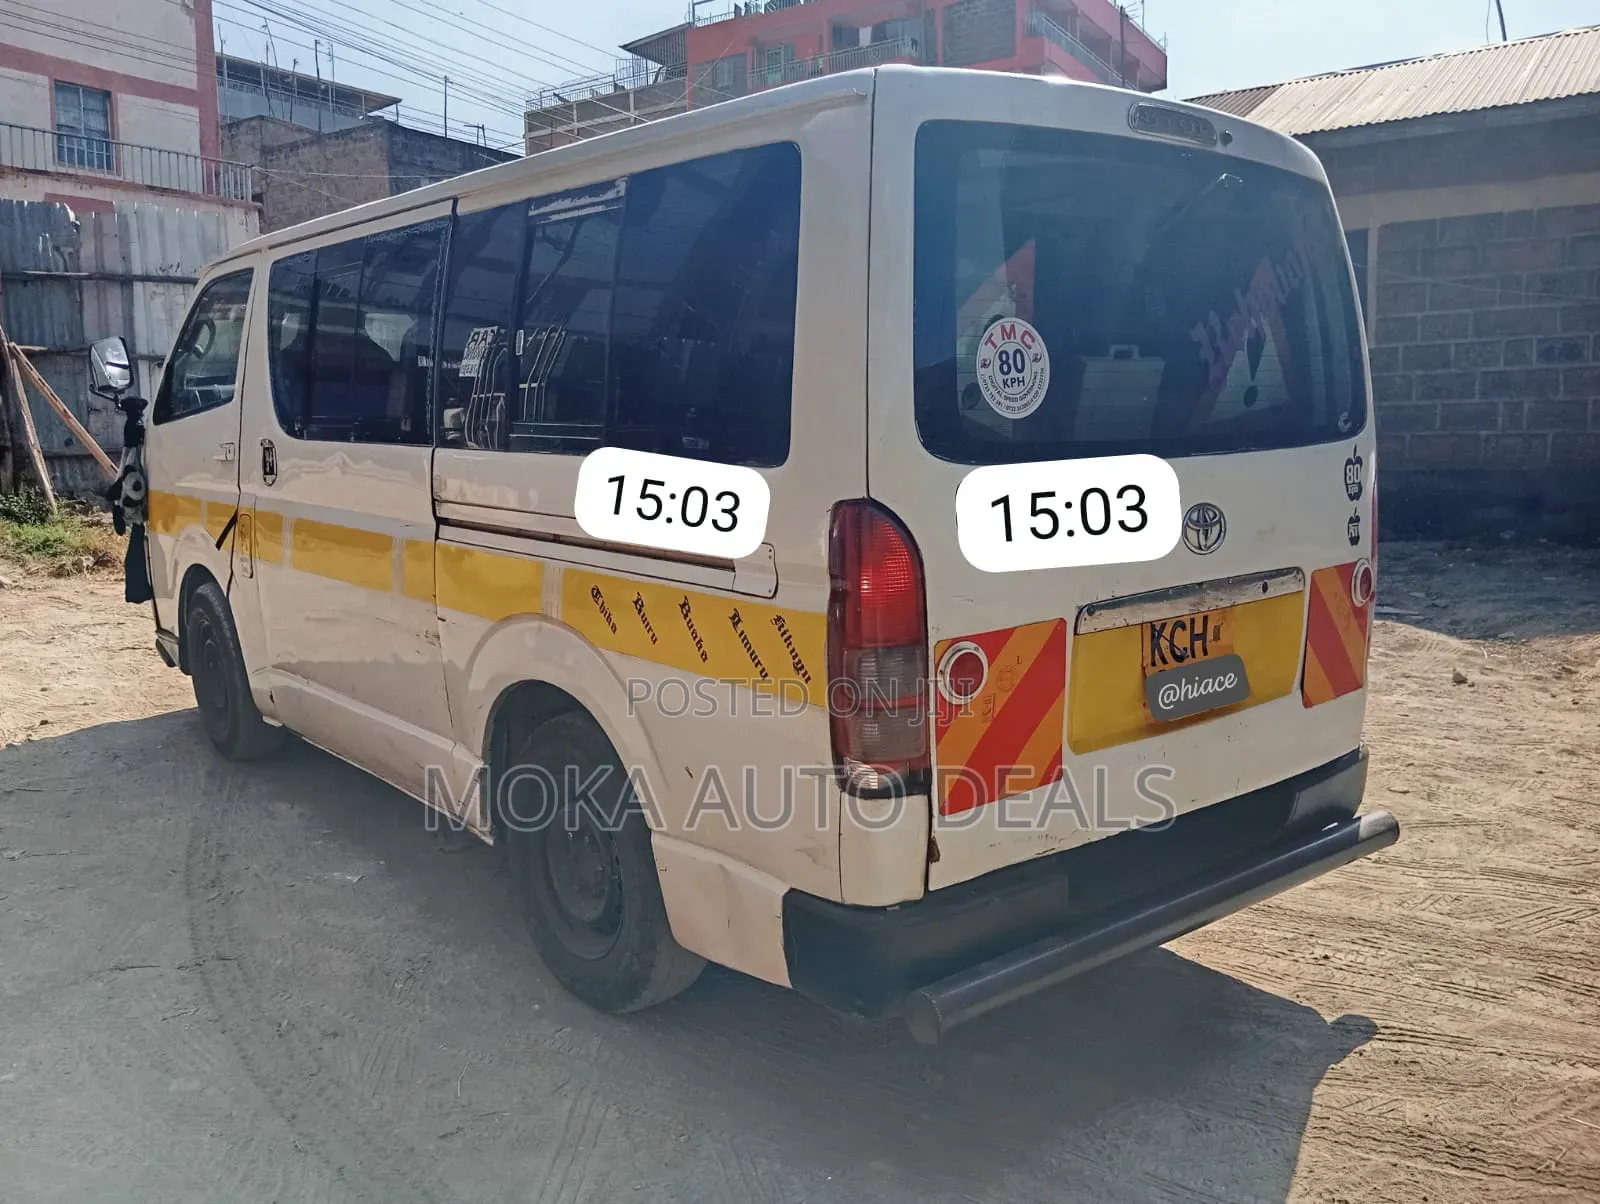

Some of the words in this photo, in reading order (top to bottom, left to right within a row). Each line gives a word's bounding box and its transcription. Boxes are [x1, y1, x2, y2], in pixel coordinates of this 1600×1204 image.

[984, 324, 1036, 350] TMC
[998, 348, 1026, 376] 80
[1002, 376, 1026, 389] KPH
[1346, 463, 1361, 485] 80
[728, 607, 769, 681] Limuru
[1150, 615, 1209, 668] KCH
